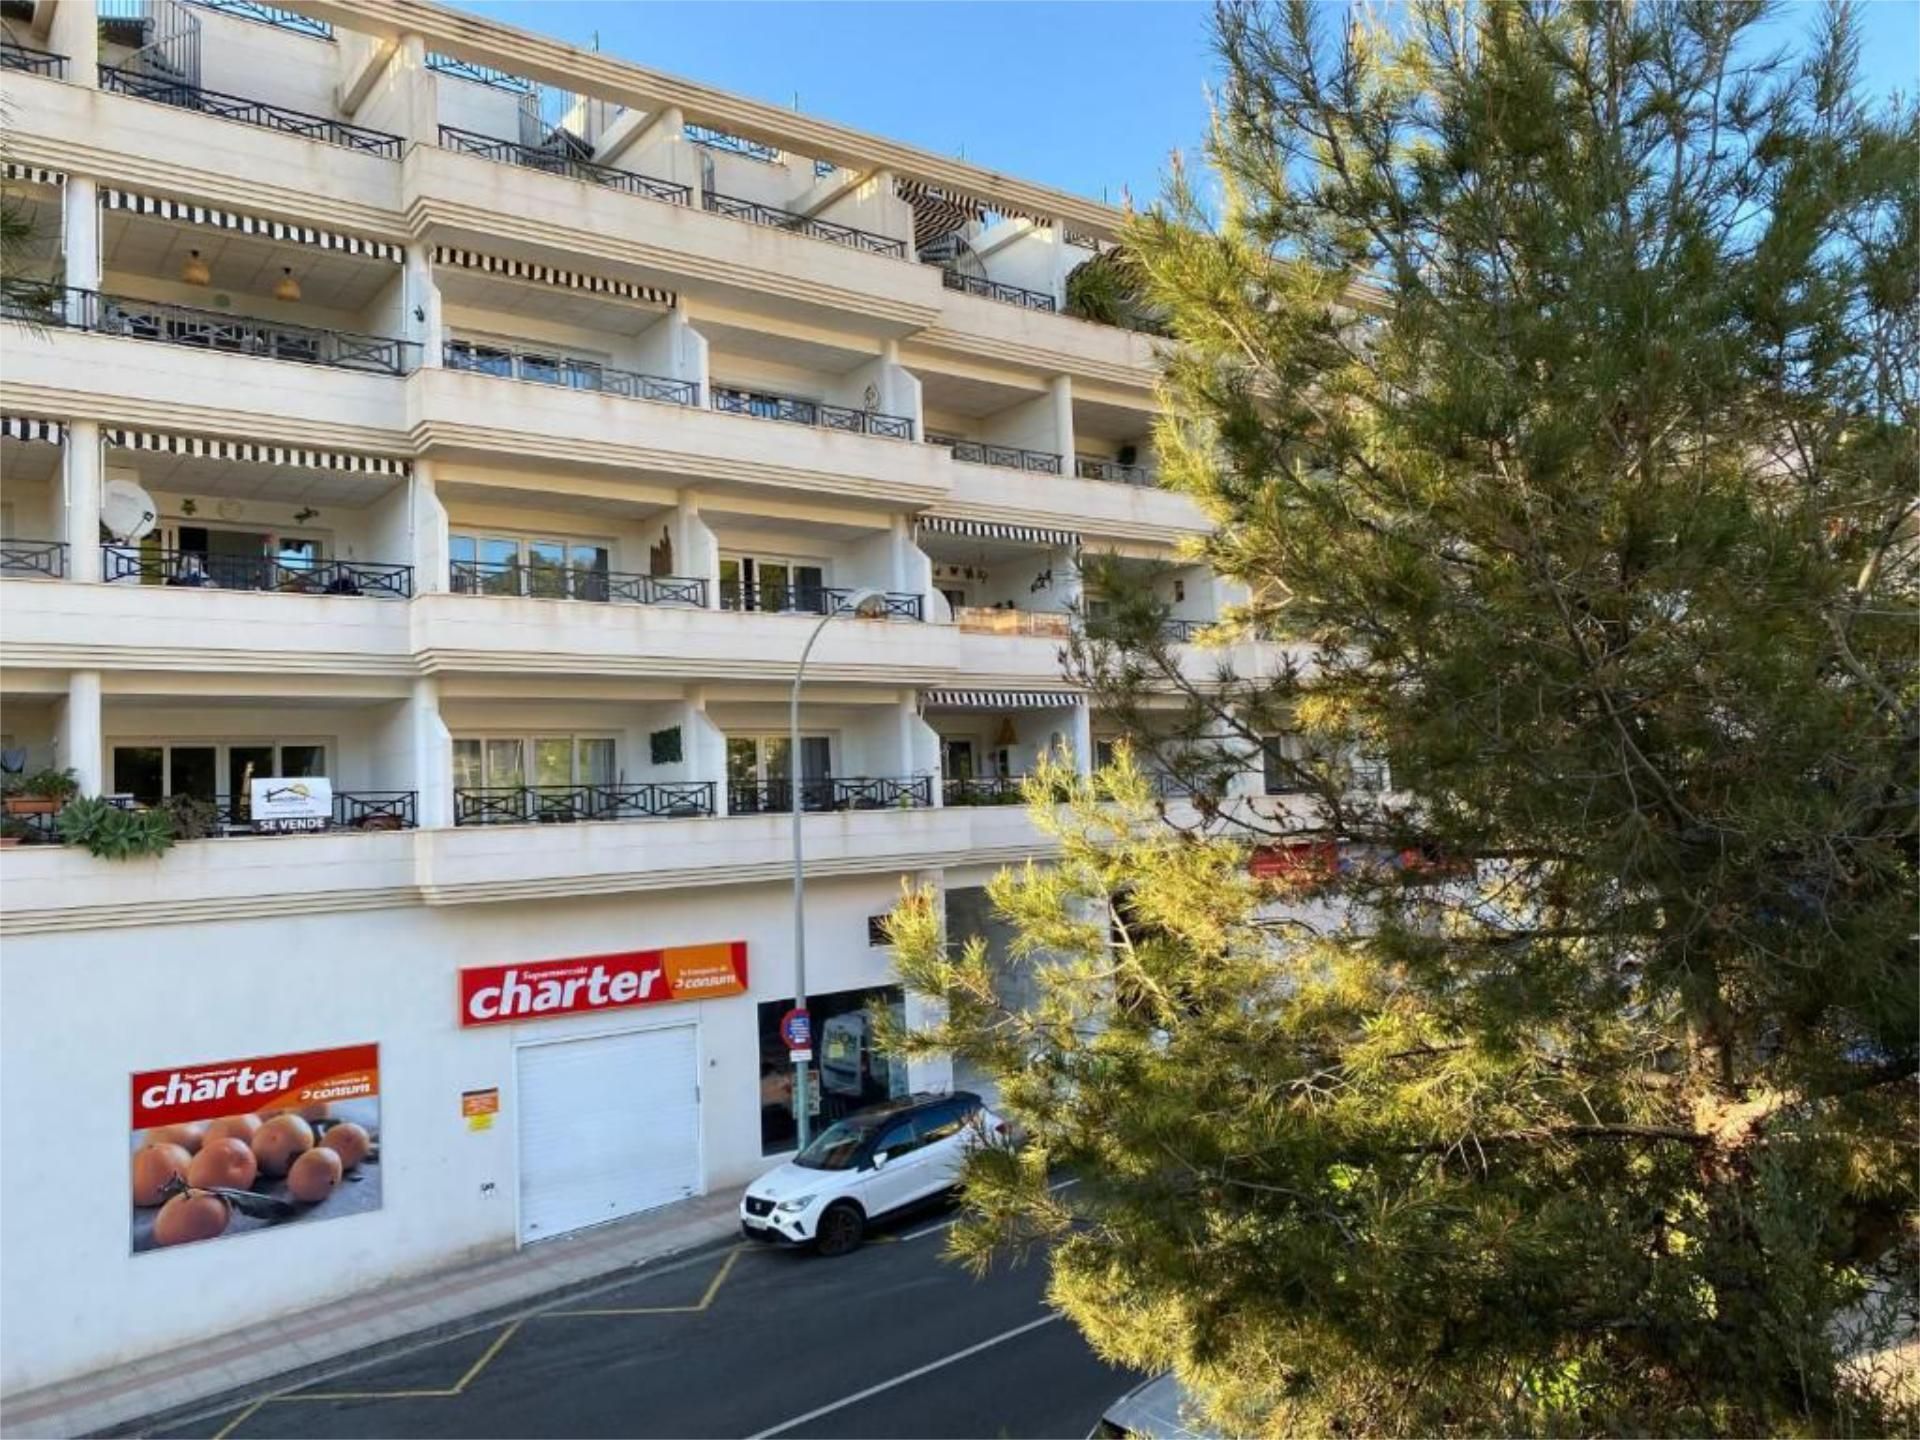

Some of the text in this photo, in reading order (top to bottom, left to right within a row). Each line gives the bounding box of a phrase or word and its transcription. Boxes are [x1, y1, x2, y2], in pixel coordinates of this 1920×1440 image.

[259, 818, 326, 831] SE VENDE
[468, 964, 662, 1019] charter
[141, 1066, 298, 1110] charter
[312, 1083, 370, 1100] consum
